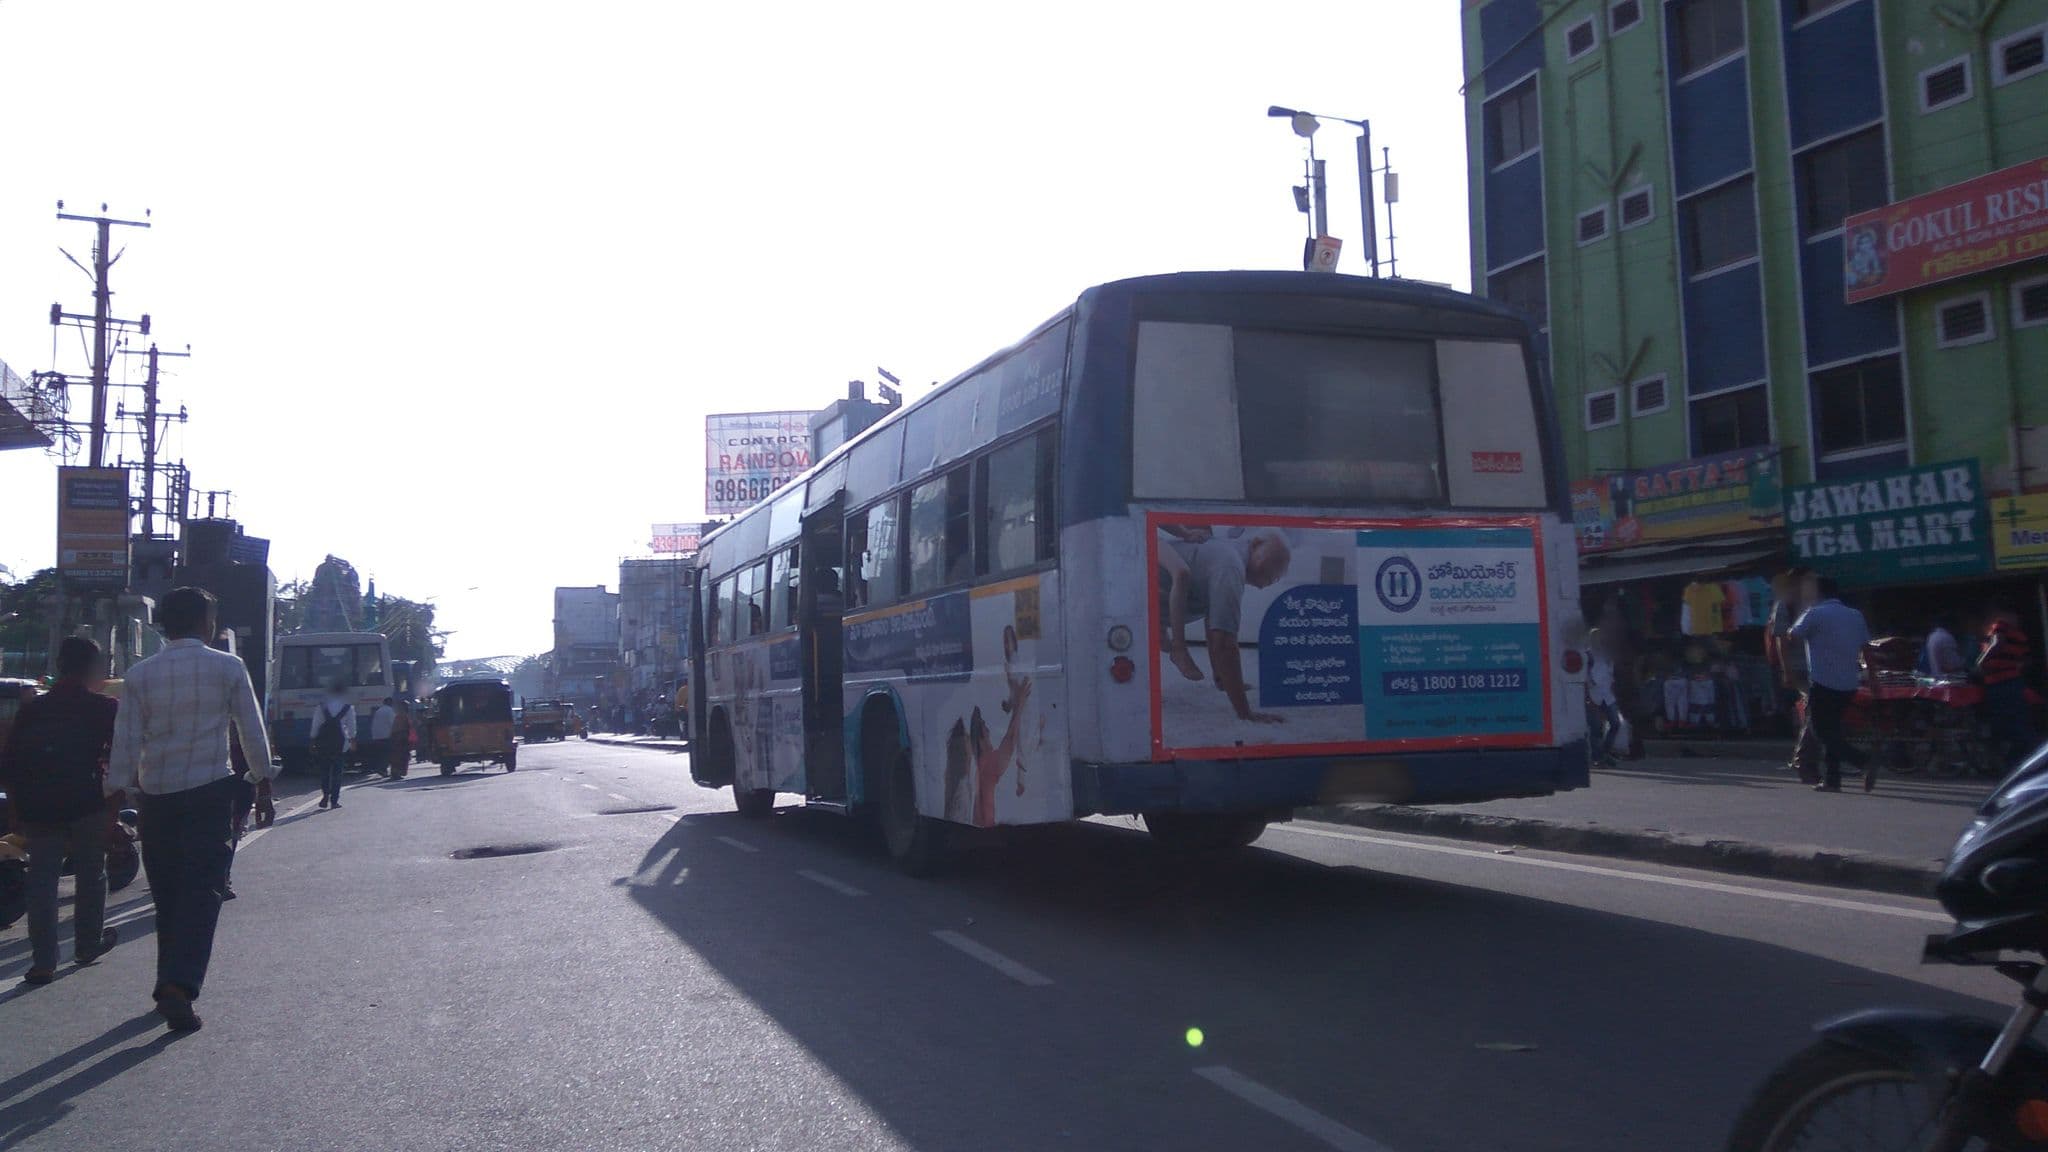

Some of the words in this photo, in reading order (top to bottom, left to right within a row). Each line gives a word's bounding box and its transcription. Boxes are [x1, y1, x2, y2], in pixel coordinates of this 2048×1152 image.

[1887, 202, 1977, 252] GOKUL
[728, 435, 811, 447] CONTACT
[1790, 466, 1974, 523] JAWAHAR
[1793, 522, 1861, 558] TEA
[1869, 509, 1975, 551] MART
[1423, 676, 1456, 690] 1800
[1460, 675, 1485, 689] 108
[1488, 673, 1520, 688] 1212
